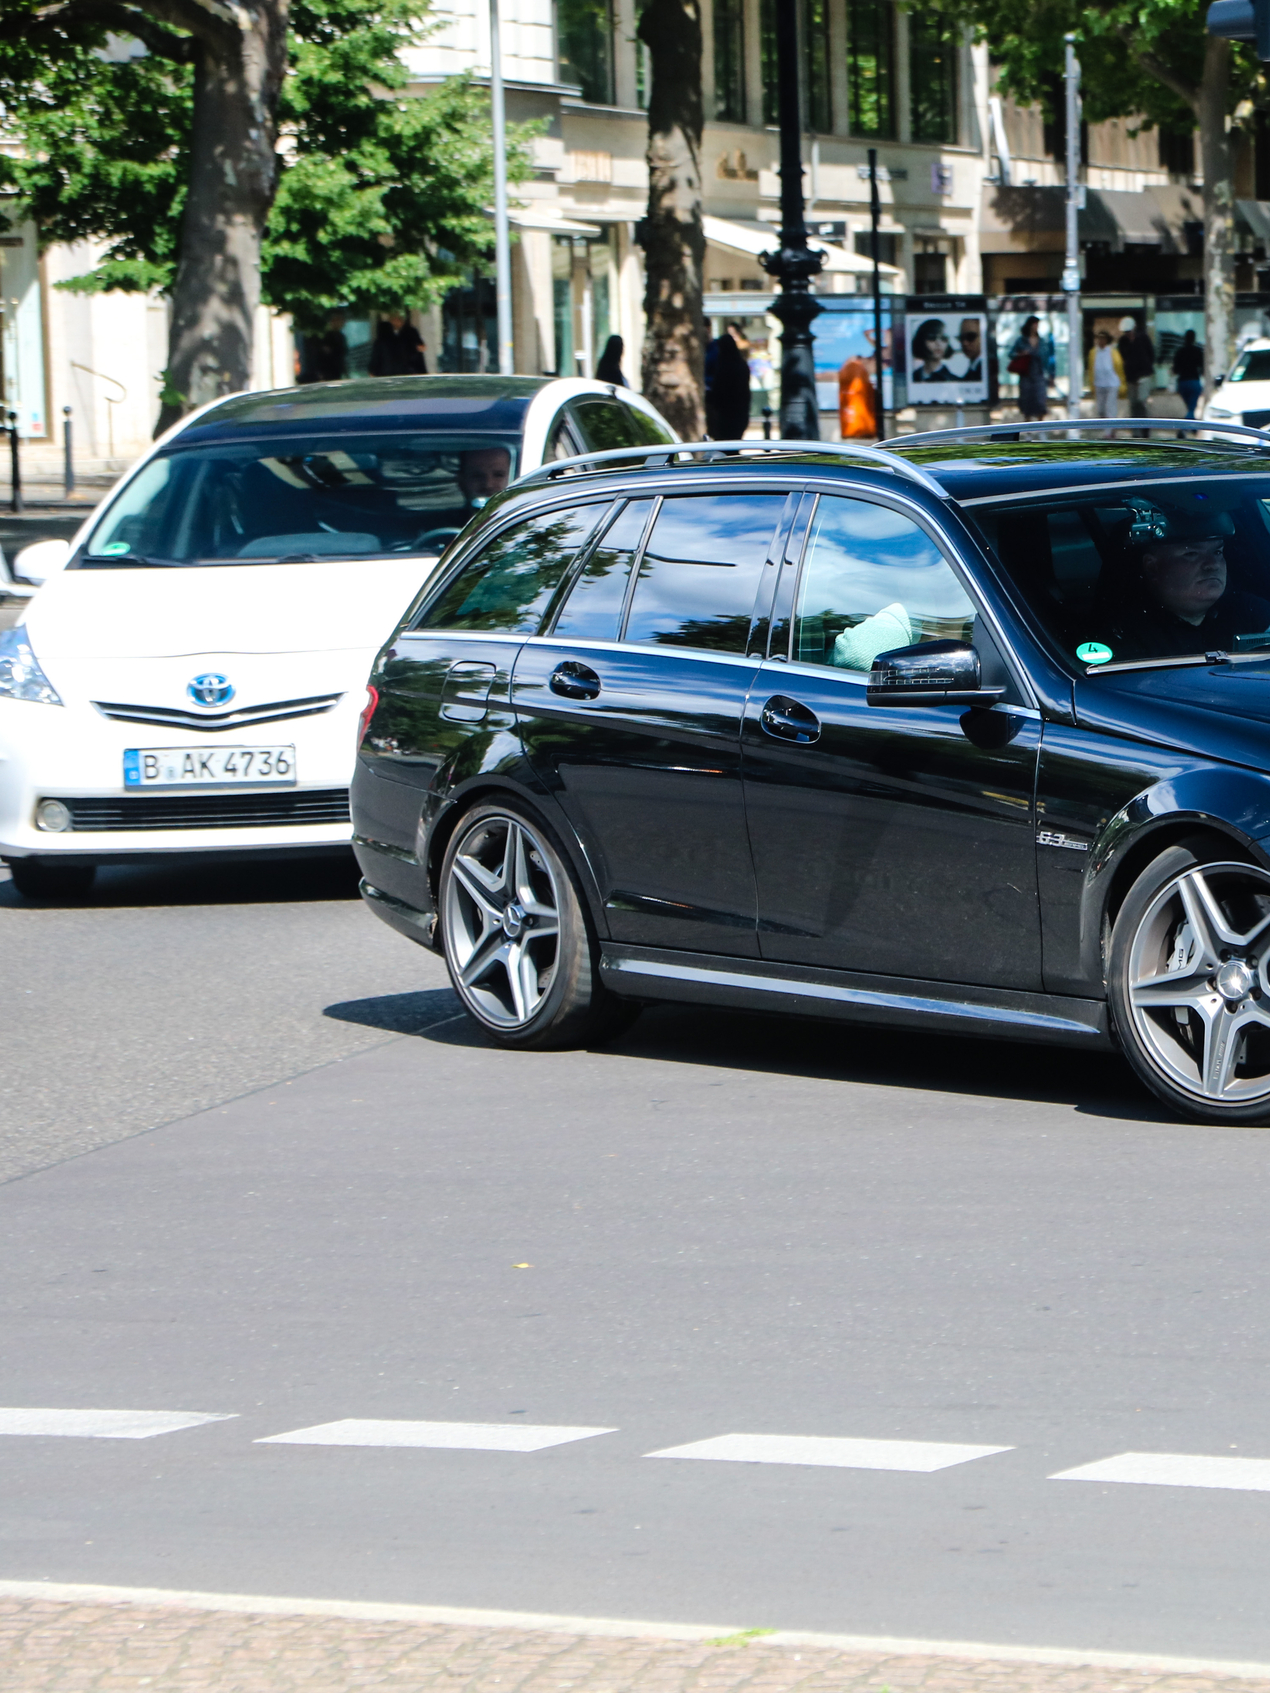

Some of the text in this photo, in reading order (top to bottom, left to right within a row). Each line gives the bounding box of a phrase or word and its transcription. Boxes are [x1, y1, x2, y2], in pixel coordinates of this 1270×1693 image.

[1087, 643, 1098, 653] 4
[144, 751, 290, 780] B AK 4736
